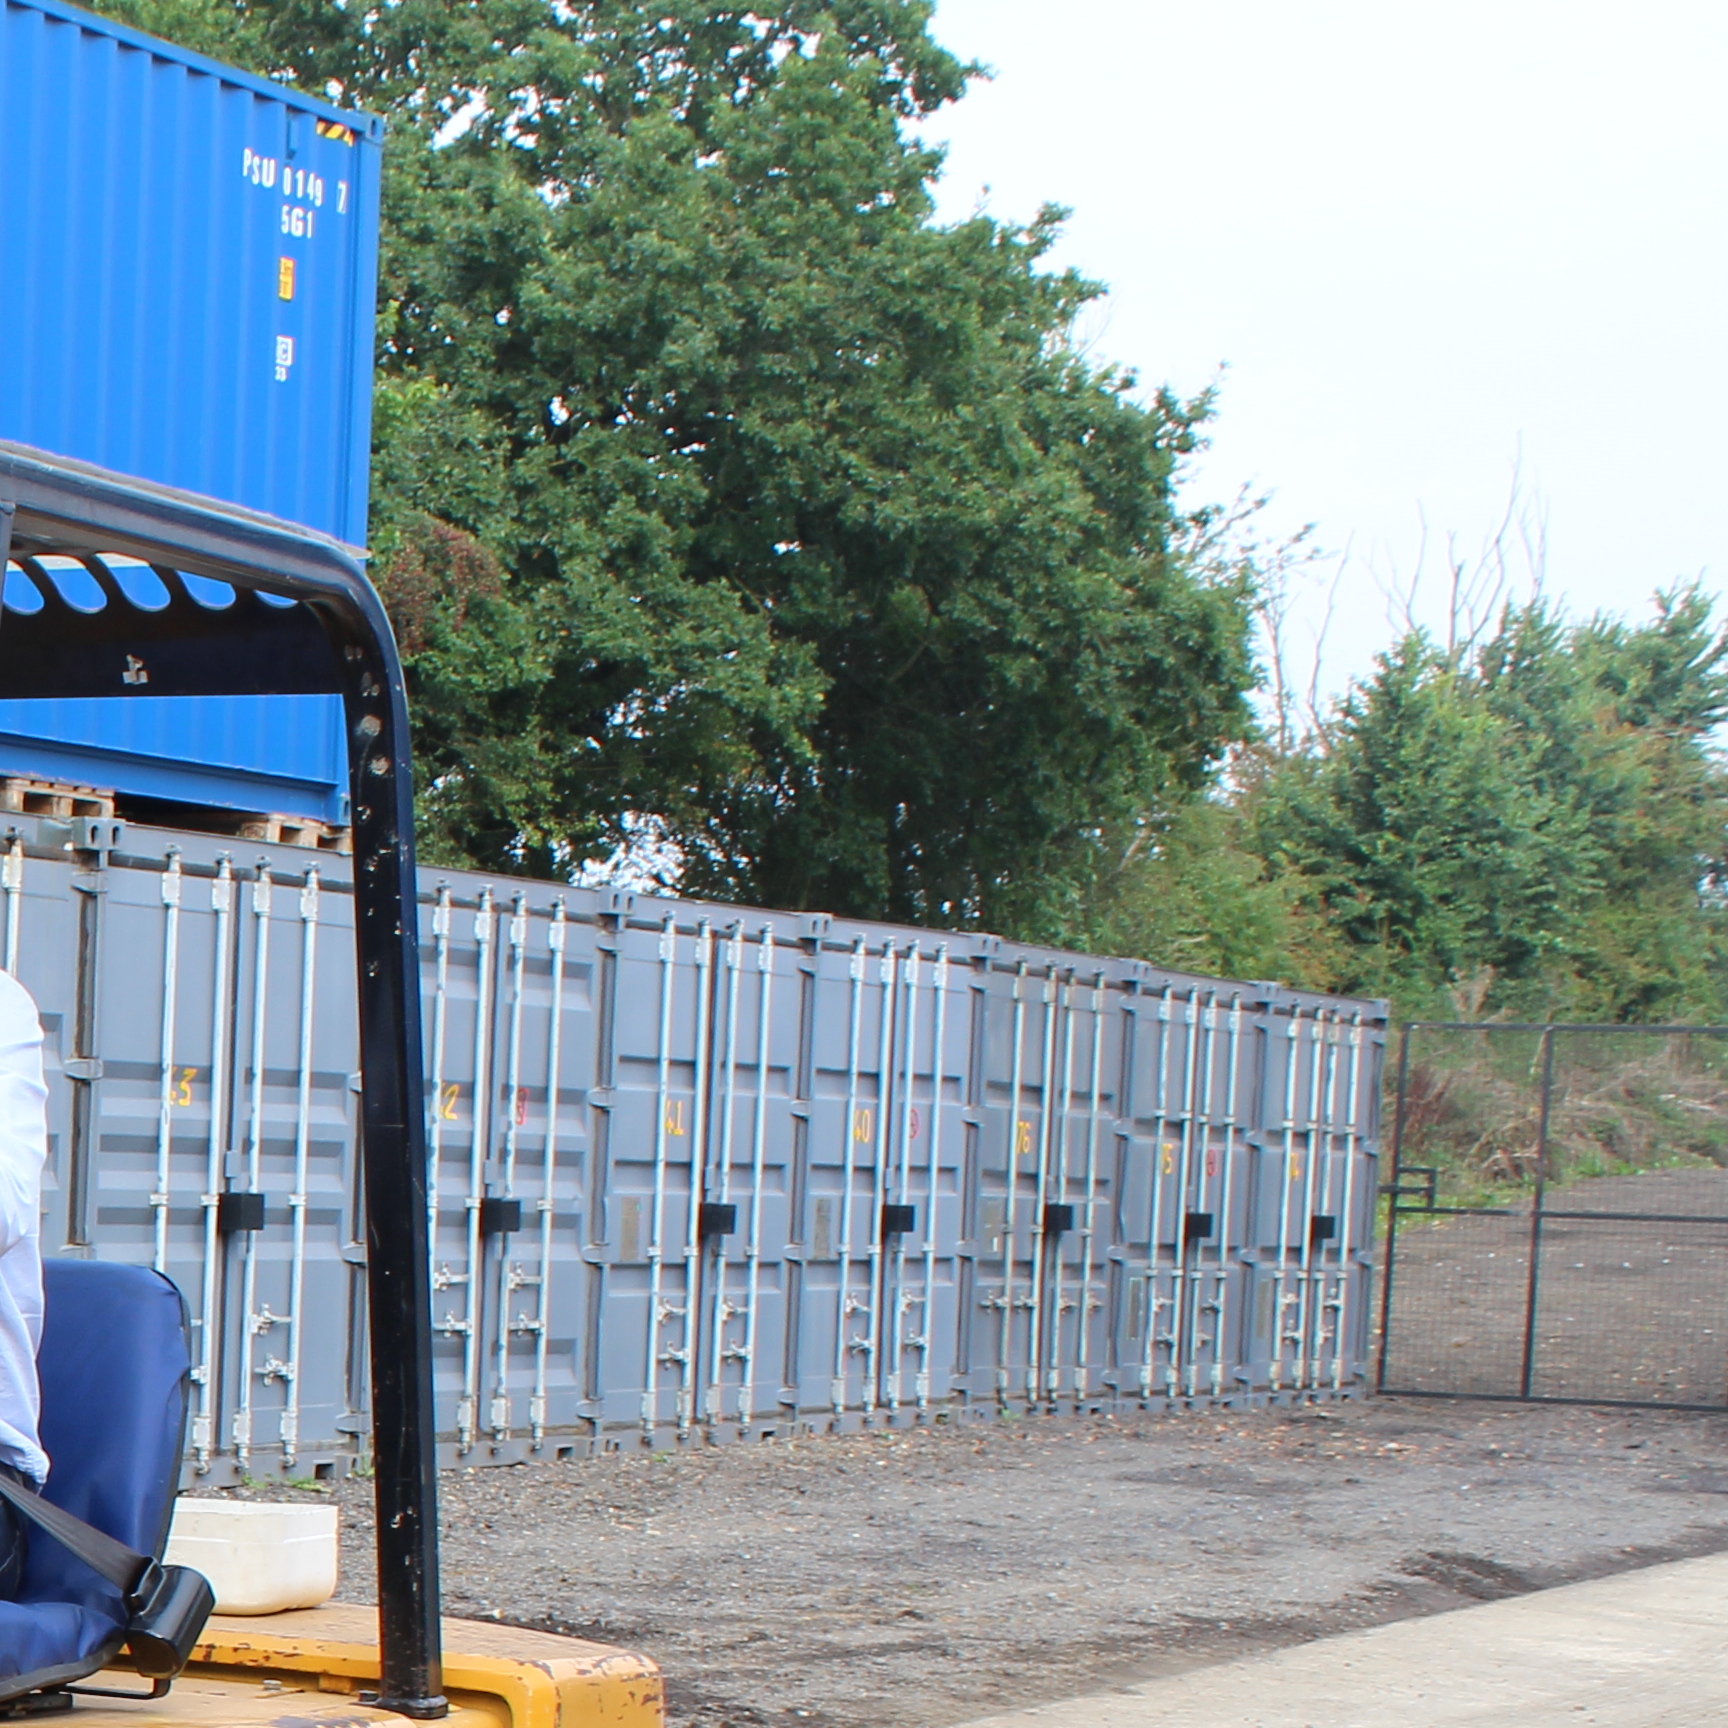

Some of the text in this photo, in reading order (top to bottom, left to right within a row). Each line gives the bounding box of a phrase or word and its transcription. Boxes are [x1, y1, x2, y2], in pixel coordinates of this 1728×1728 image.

[337, 181, 349, 214] 7
[170, 1065, 199, 1106] 3
[440, 1081, 460, 1120] 2
